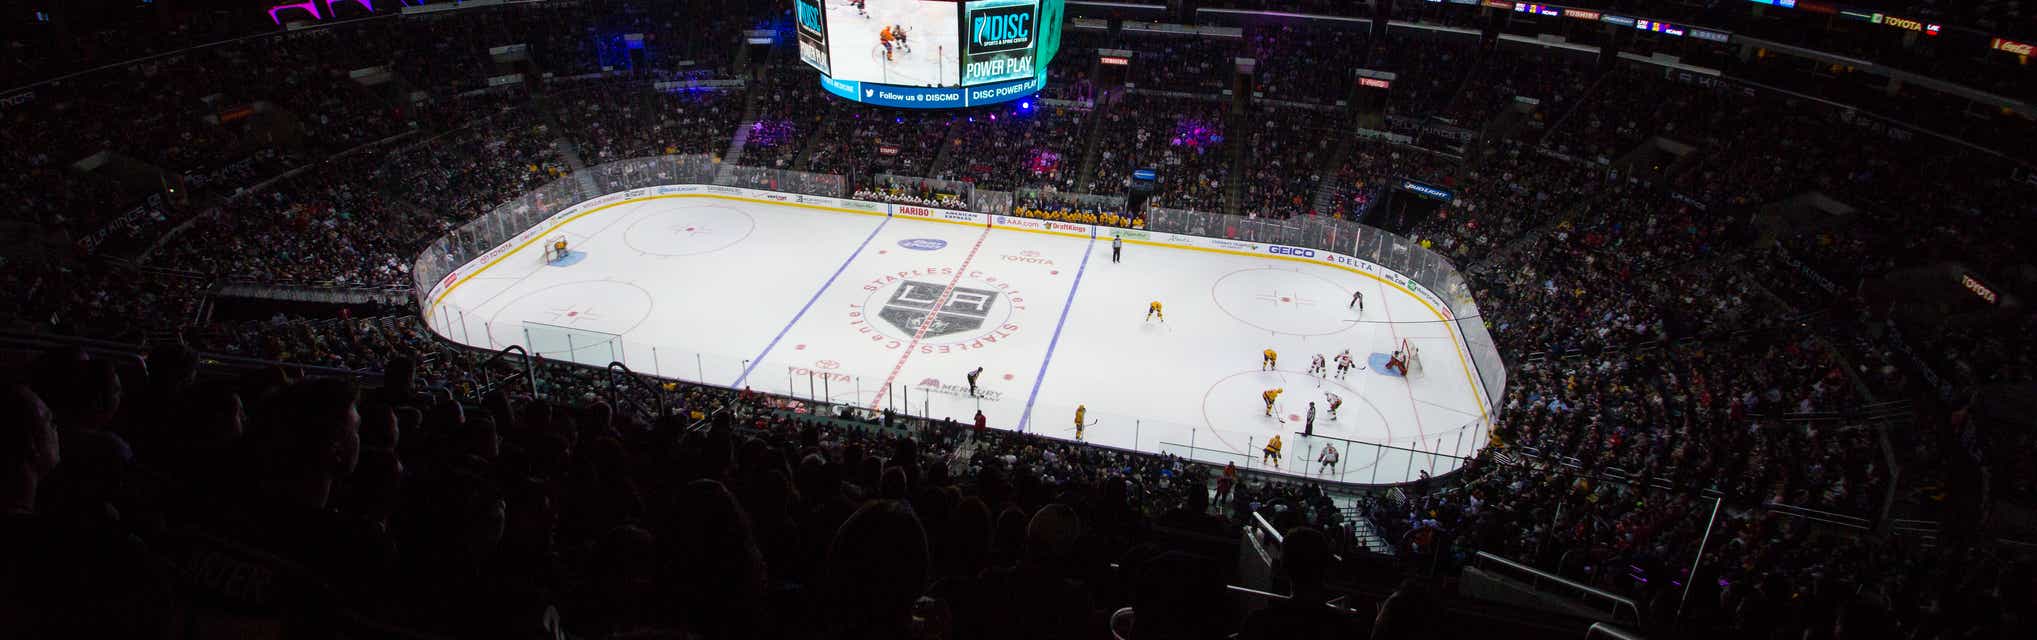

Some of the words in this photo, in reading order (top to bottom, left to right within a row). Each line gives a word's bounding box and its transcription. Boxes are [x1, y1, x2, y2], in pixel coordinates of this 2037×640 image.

[1564, 9, 1600, 20] TOSHIBA
[991, 13, 1030, 41] DISC
[1884, 16, 1922, 31] TOYOTA
[966, 59, 1004, 79] POWER
[1006, 55, 1032, 74] PLAY
[880, 91, 903, 101] Follow
[916, 94, 924, 102] @
[926, 93, 960, 102] DISCMD
[972, 89, 994, 100] DISC
[995, 84, 1023, 98] POWER
[1023, 79, 1037, 93] PLAY
[1424, 188, 1448, 198] LIGHT
[899, 206, 929, 217] HARIBO
[945, 210, 978, 219] AMERICAN
[1006, 219, 1039, 229] AAA.com
[1052, 221, 1086, 233] DraftKings
[489, 242, 513, 259] TOYOTA
[1268, 245, 1315, 259] GEICO
[1000, 254, 1056, 266] TOYOTA
[1338, 257, 1373, 272] DELTA
[863, 267, 953, 293] STAPLES
[969, 270, 1025, 312] Center
[1961, 274, 1996, 304] TOYOTA
[896, 284, 990, 312] LA
[849, 303, 902, 351] Center
[920, 322, 1019, 355] STAPLES
[788, 366, 852, 383] TOYOTA
